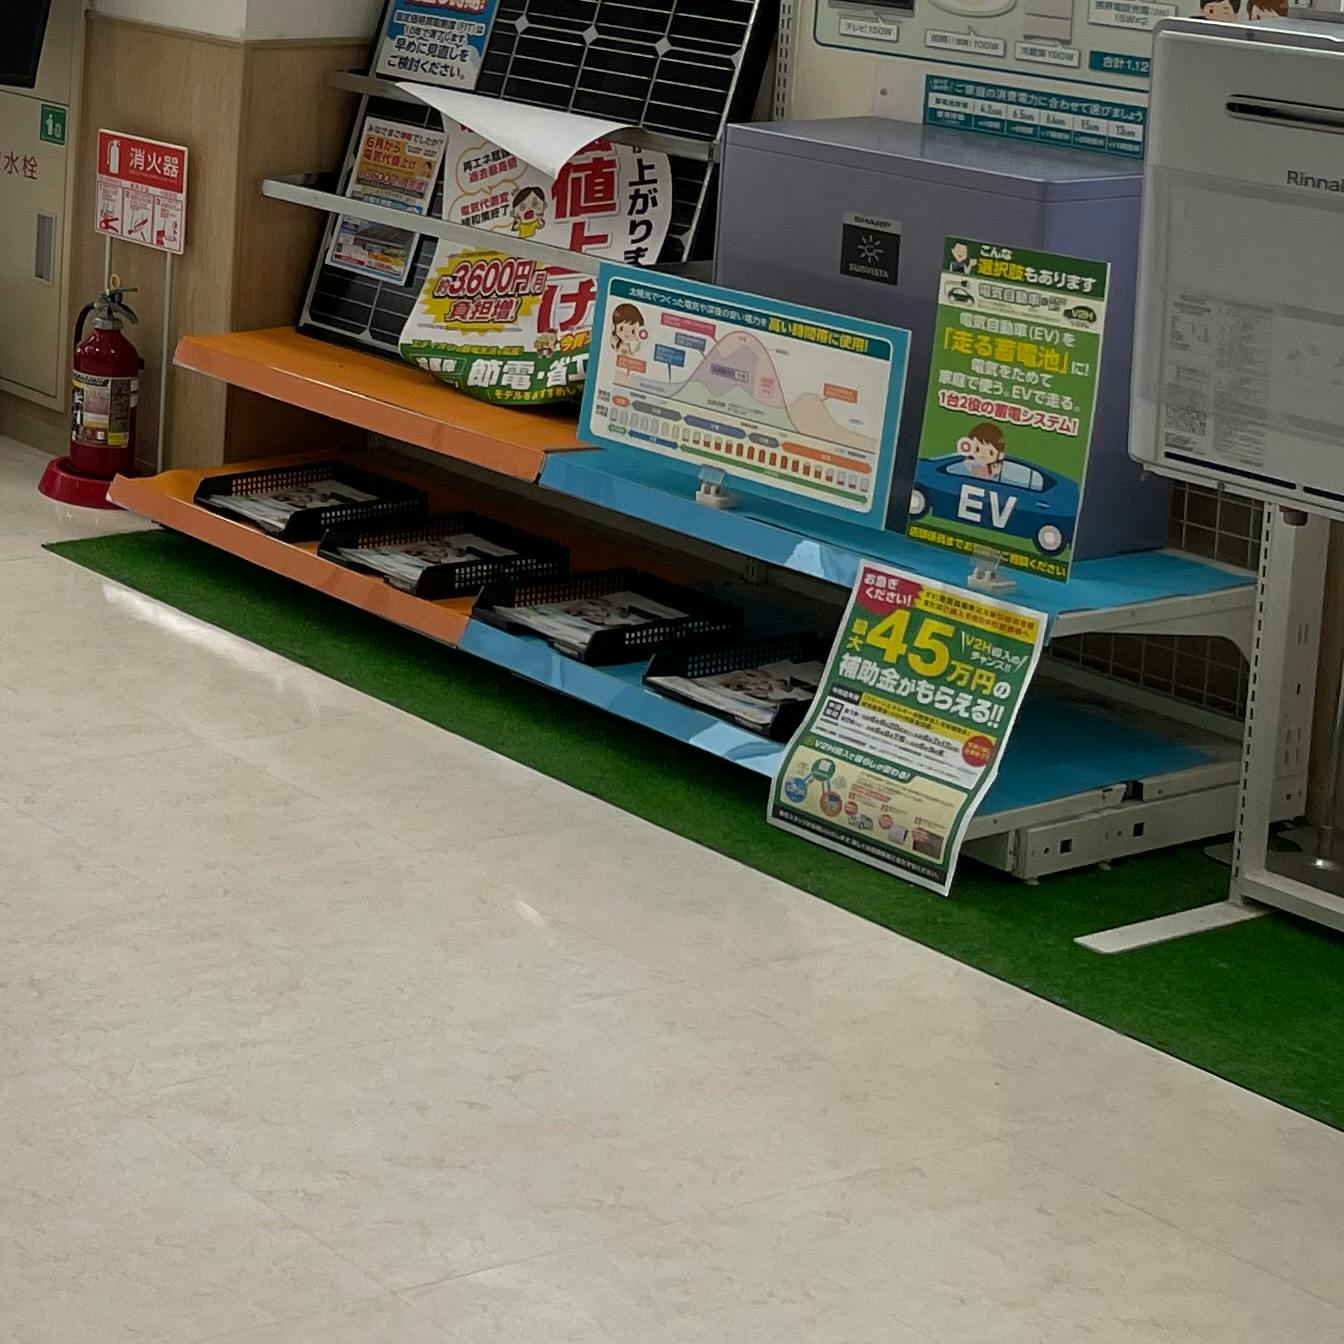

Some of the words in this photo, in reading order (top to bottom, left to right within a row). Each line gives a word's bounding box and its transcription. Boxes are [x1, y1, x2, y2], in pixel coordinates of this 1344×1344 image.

[394, 38, 471, 64] 早めに見直しを
[386, 54, 466, 81] ご検討ください。
[365, 136, 402, 155] 6月から
[128, 146, 180, 179] 消火器
[853, 216, 892, 229] SHARP
[979, 243, 1014, 260] こんな
[977, 258, 1098, 293] 選択肢もあります
[445, 299, 520, 321] 負担増!
[970, 357, 1054, 388] 電気をためて
[938, 390, 1080, 436] 1台2役の蓄電システム!
[957, 484, 1018, 530] EV
[864, 572, 899, 591] お急ぎ
[865, 588, 913, 607] ください!
[837, 651, 1006, 729] 補助金がもらえる!!
